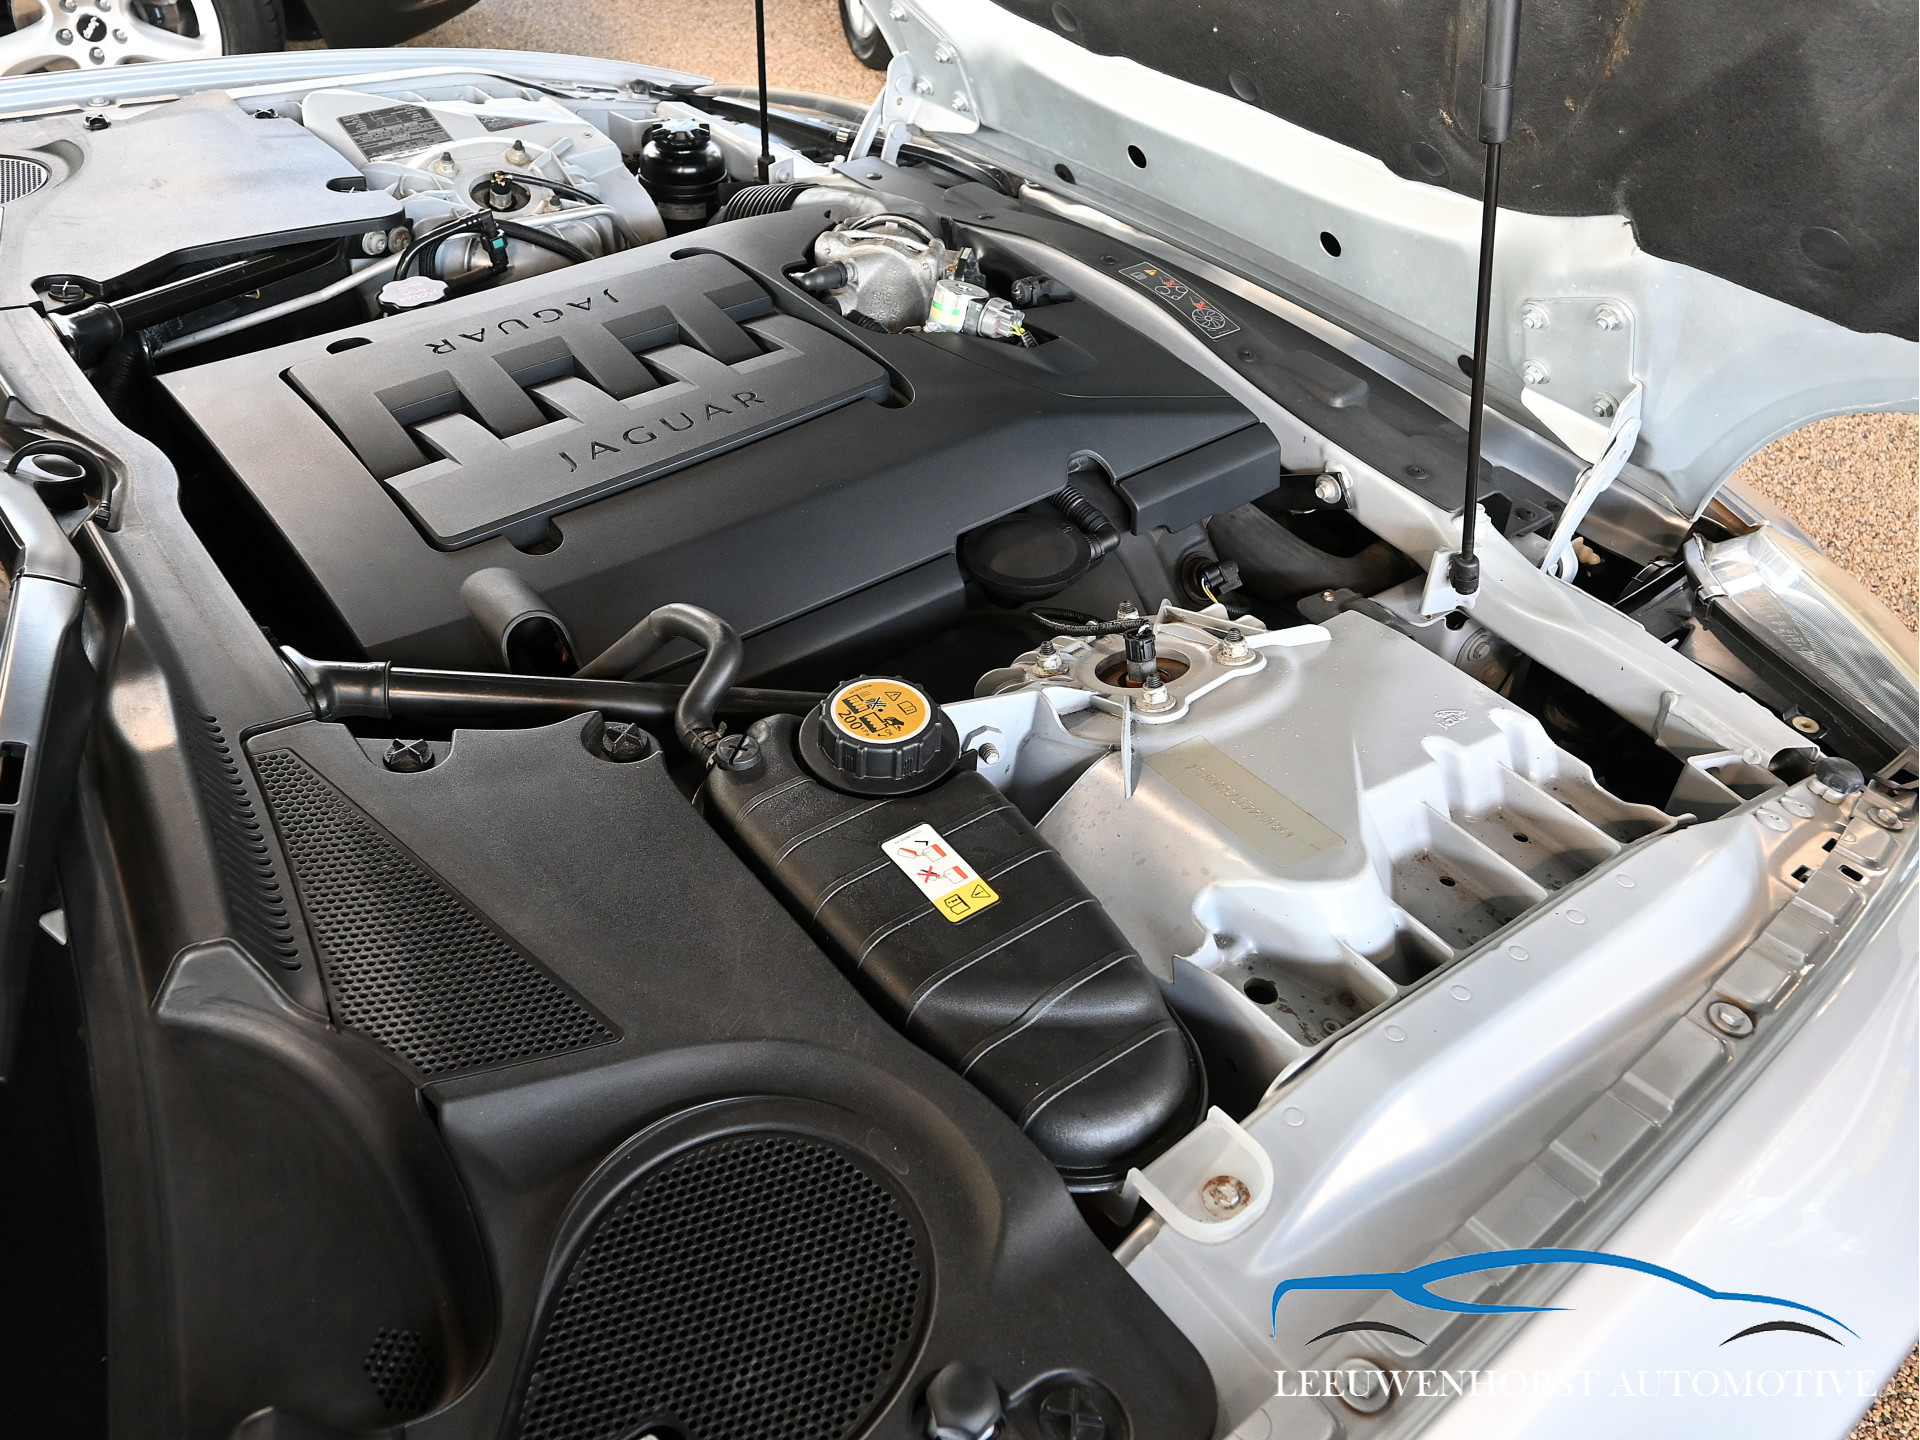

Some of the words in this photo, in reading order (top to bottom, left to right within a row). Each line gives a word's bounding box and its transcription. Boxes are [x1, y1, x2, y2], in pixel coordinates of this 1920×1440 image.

[82, 16, 100, 39] Jeep
[424, 288, 620, 355] JAGUAR
[558, 390, 766, 473] JAGUAR
[837, 709, 863, 730] 200
